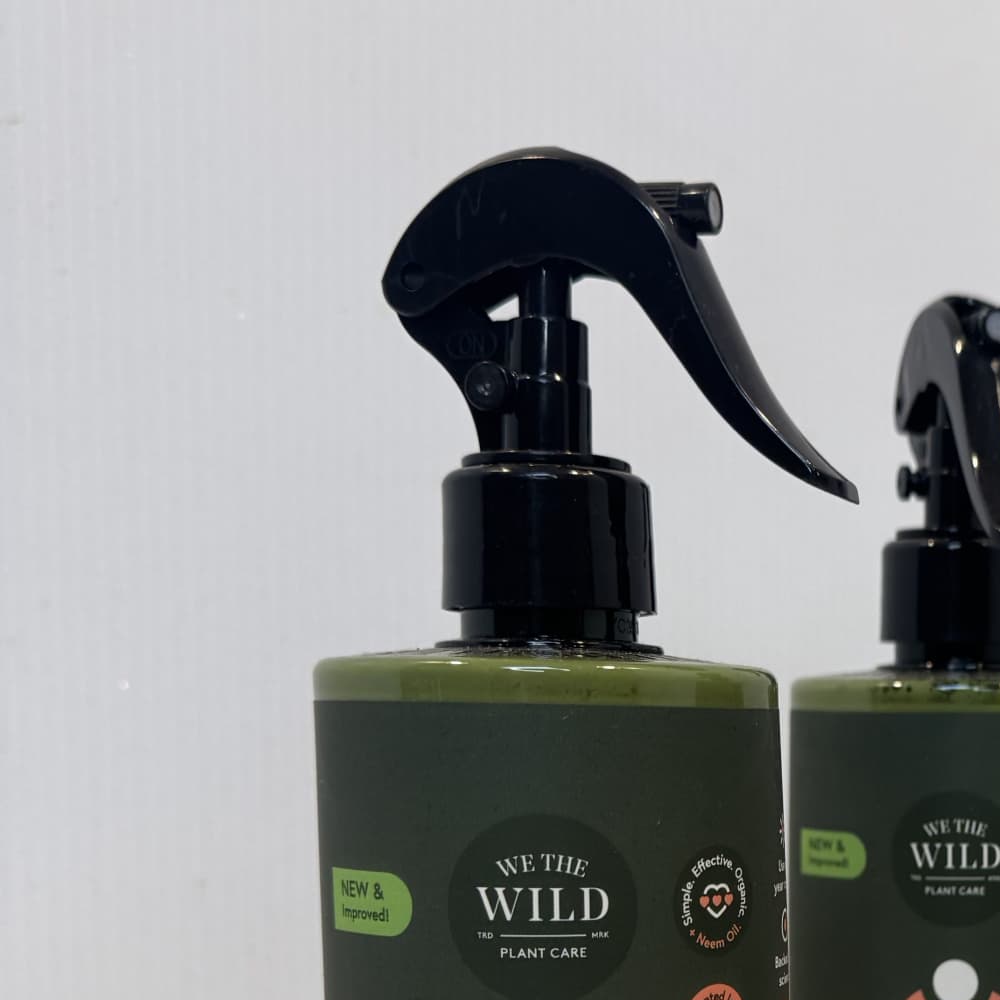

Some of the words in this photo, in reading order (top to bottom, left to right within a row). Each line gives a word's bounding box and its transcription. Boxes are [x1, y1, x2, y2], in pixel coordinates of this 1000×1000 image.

[923, 819, 951, 837] WE
[953, 818, 988, 838] THE
[496, 854, 535, 877] WE
[540, 853, 589, 877] THE
[341, 879, 369, 899] NEW
[373, 882, 385, 900] &
[681, 880, 696, 927] Simple.
[691, 853, 733, 878] Effective.
[958, 885, 986, 897] CARE
[342, 903, 390, 923] Improved!
[476, 886, 610, 922] WILD
[477, 931, 494, 940] TRD
[696, 932, 725, 949] Neem
[500, 947, 546, 959] PLANT
[550, 947, 588, 958] CARE
